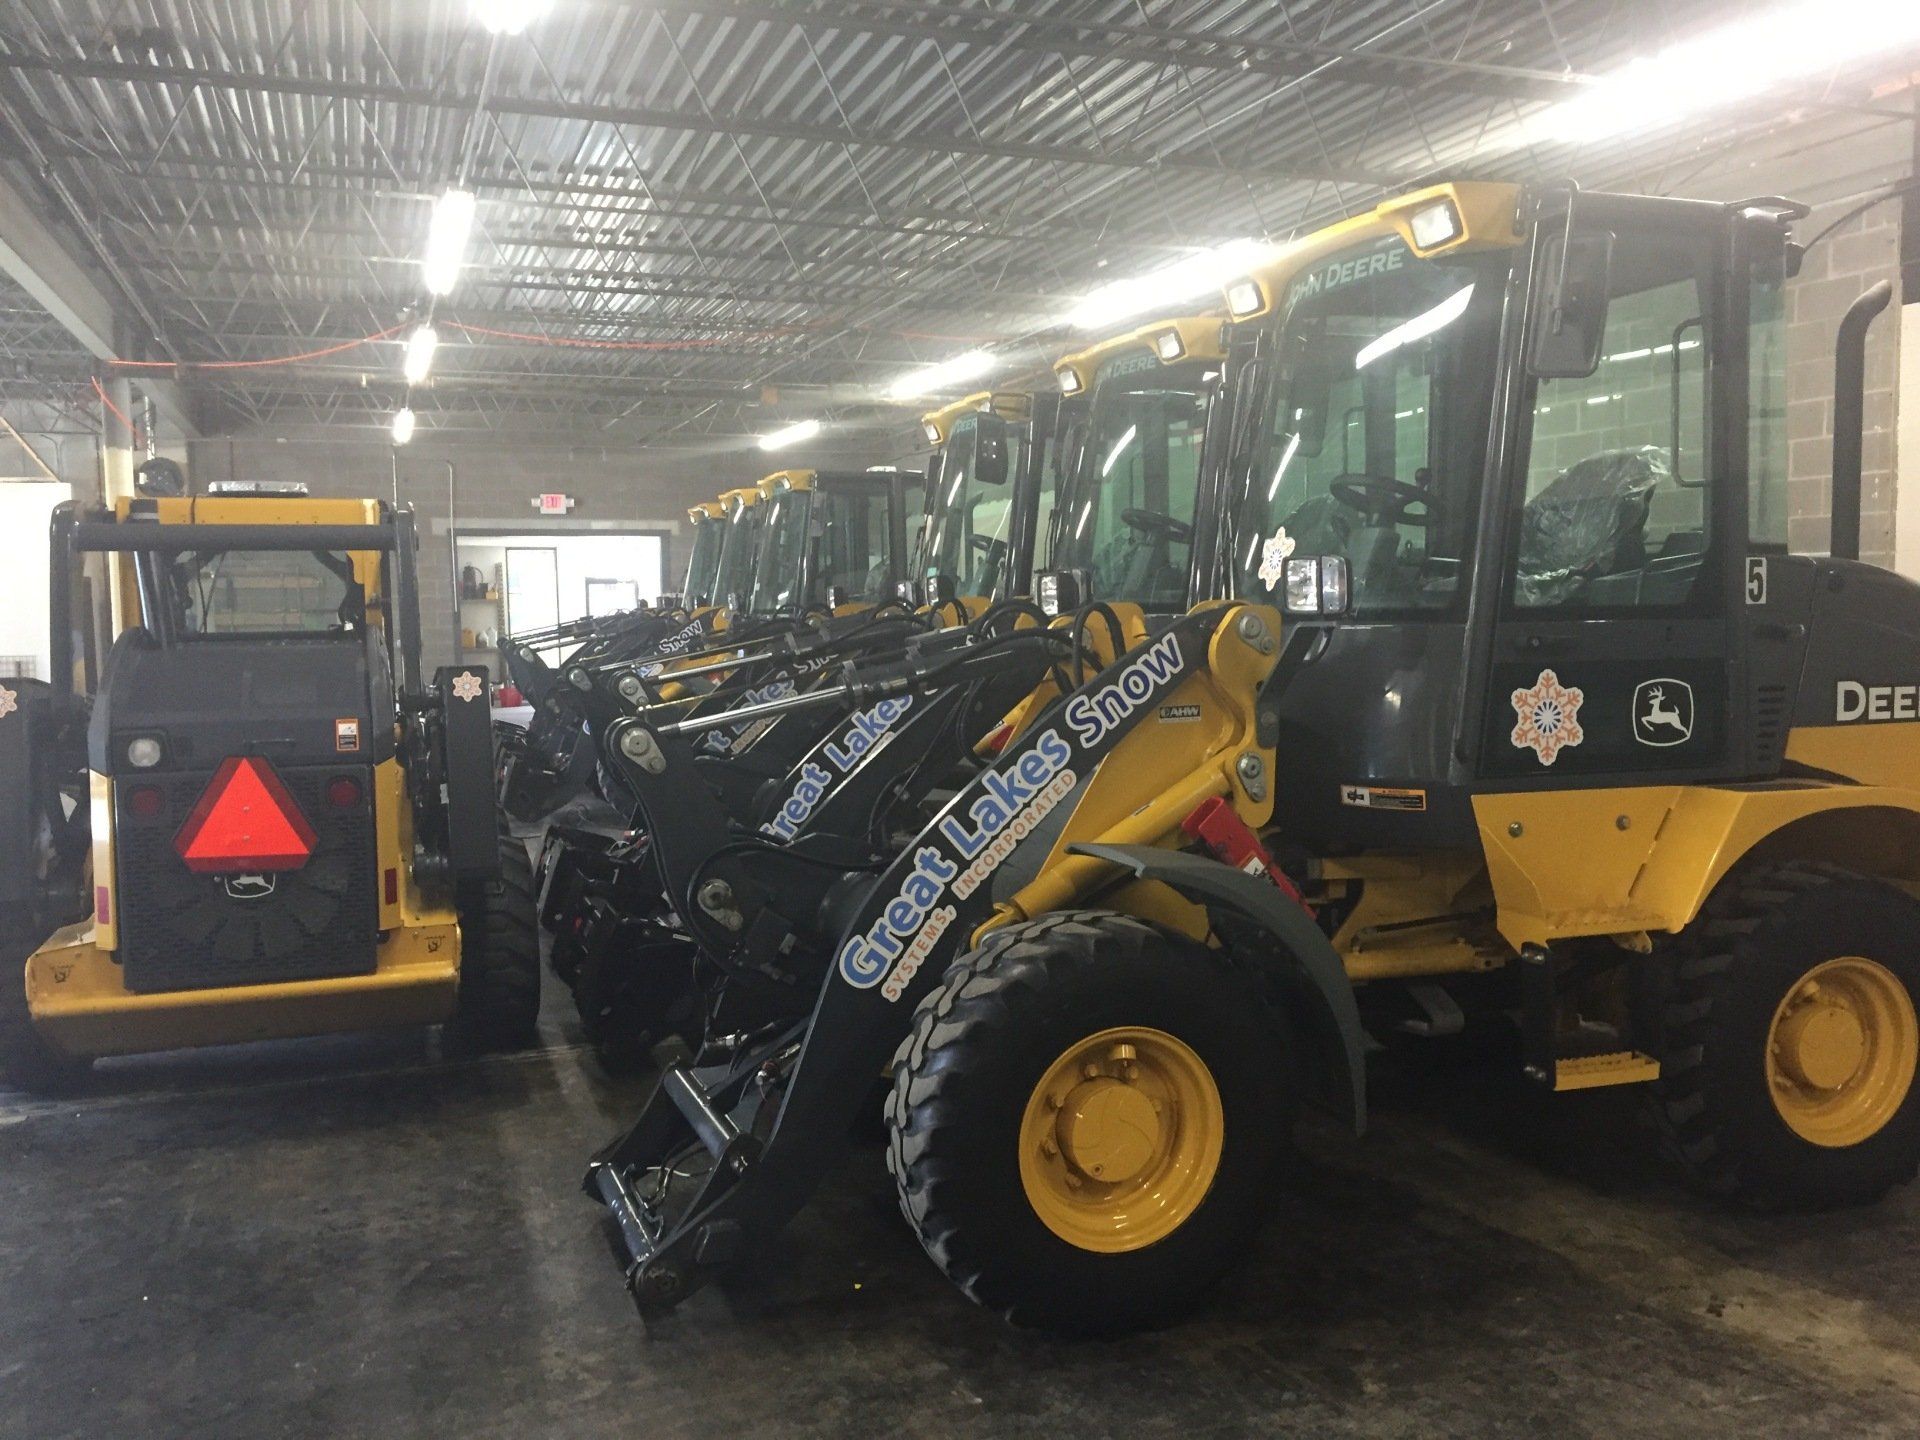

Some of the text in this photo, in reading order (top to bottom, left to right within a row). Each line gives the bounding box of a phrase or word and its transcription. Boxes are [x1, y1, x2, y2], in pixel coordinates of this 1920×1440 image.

[1325, 248, 1405, 289] DEERE
[1748, 558, 1764, 603] 5
[659, 619, 702, 653] Snow
[1836, 681, 1920, 721] DEE
[841, 633, 1183, 986] Great Lakes Snow
[883, 771, 1075, 1000] SYSTEMS, INCORPORATED
